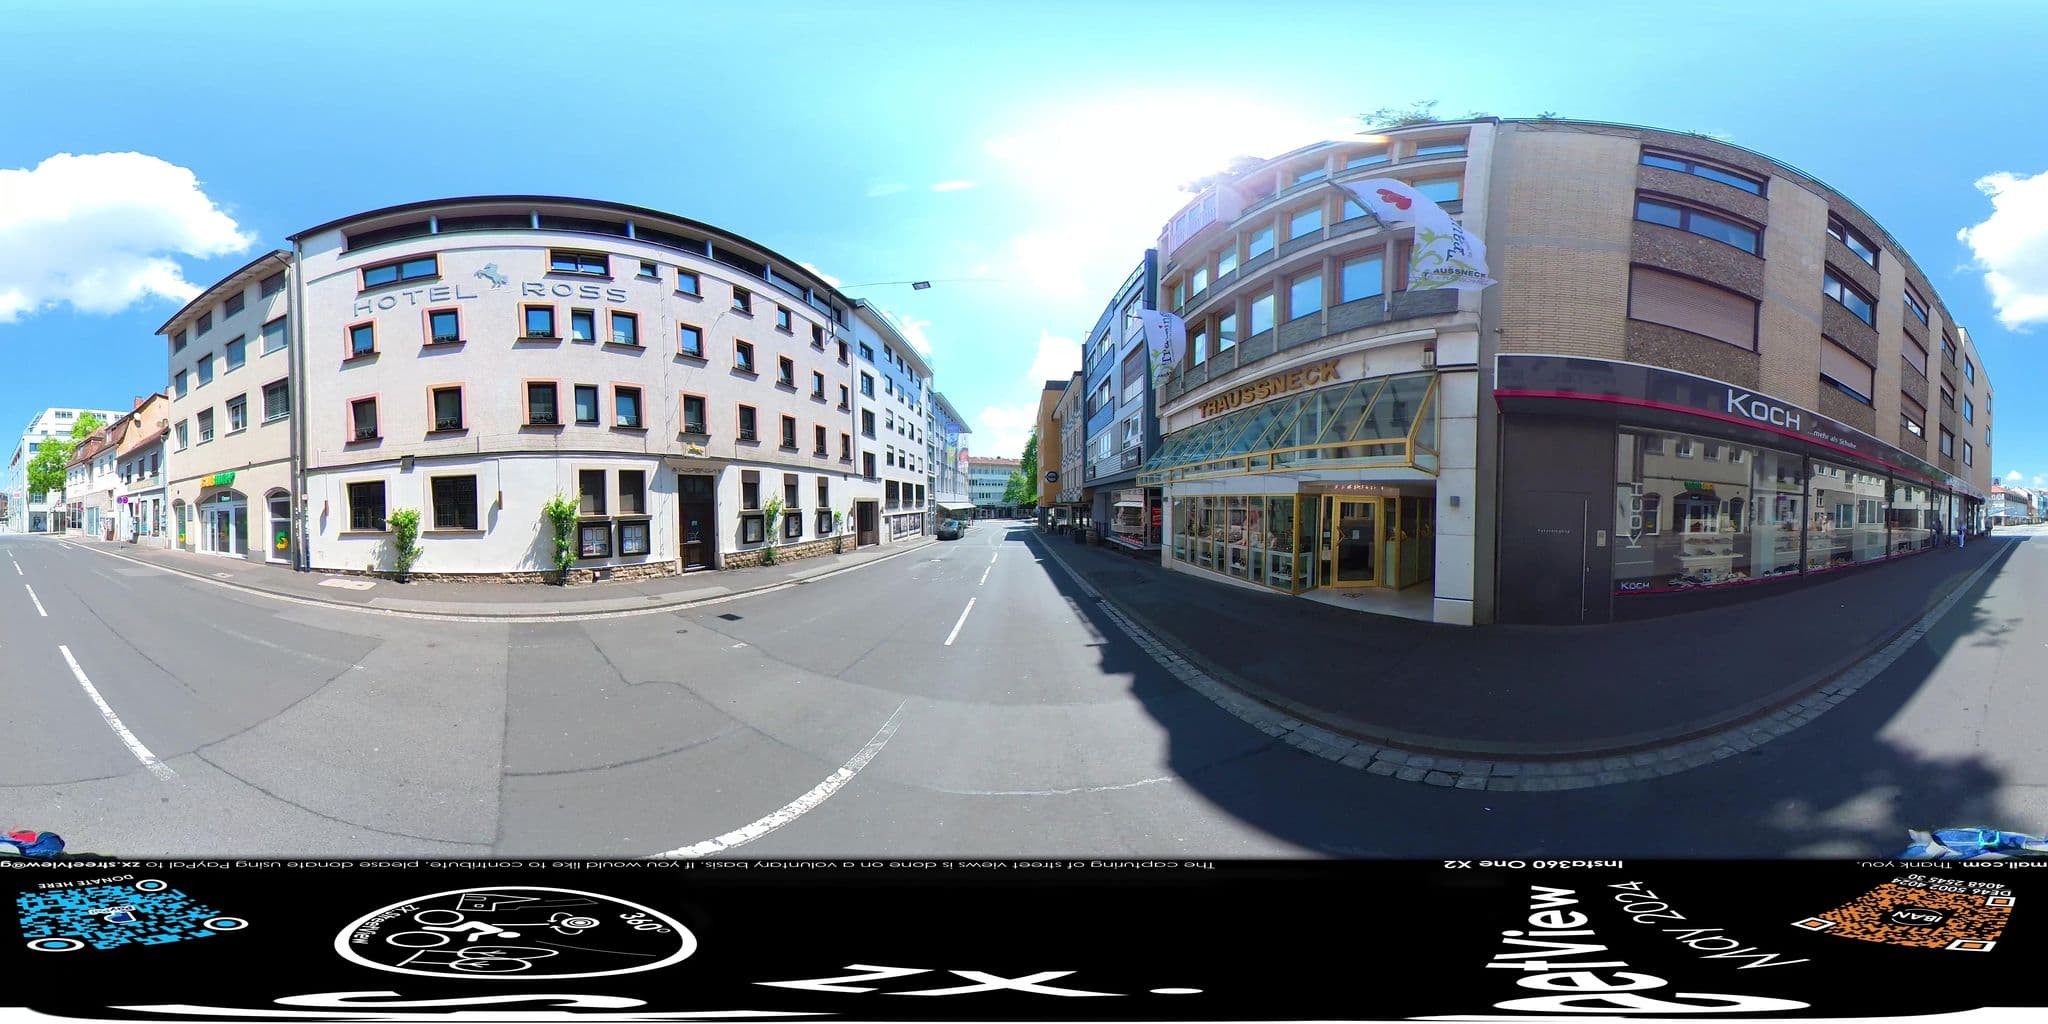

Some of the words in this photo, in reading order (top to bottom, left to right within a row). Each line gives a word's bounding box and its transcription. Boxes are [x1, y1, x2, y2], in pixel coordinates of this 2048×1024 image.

[354, 284, 478, 317] HOTEL
[522, 281, 628, 303] ROSS
[1198, 358, 1341, 419] TRAUSSNECK
[1620, 581, 1650, 591] KOCH
